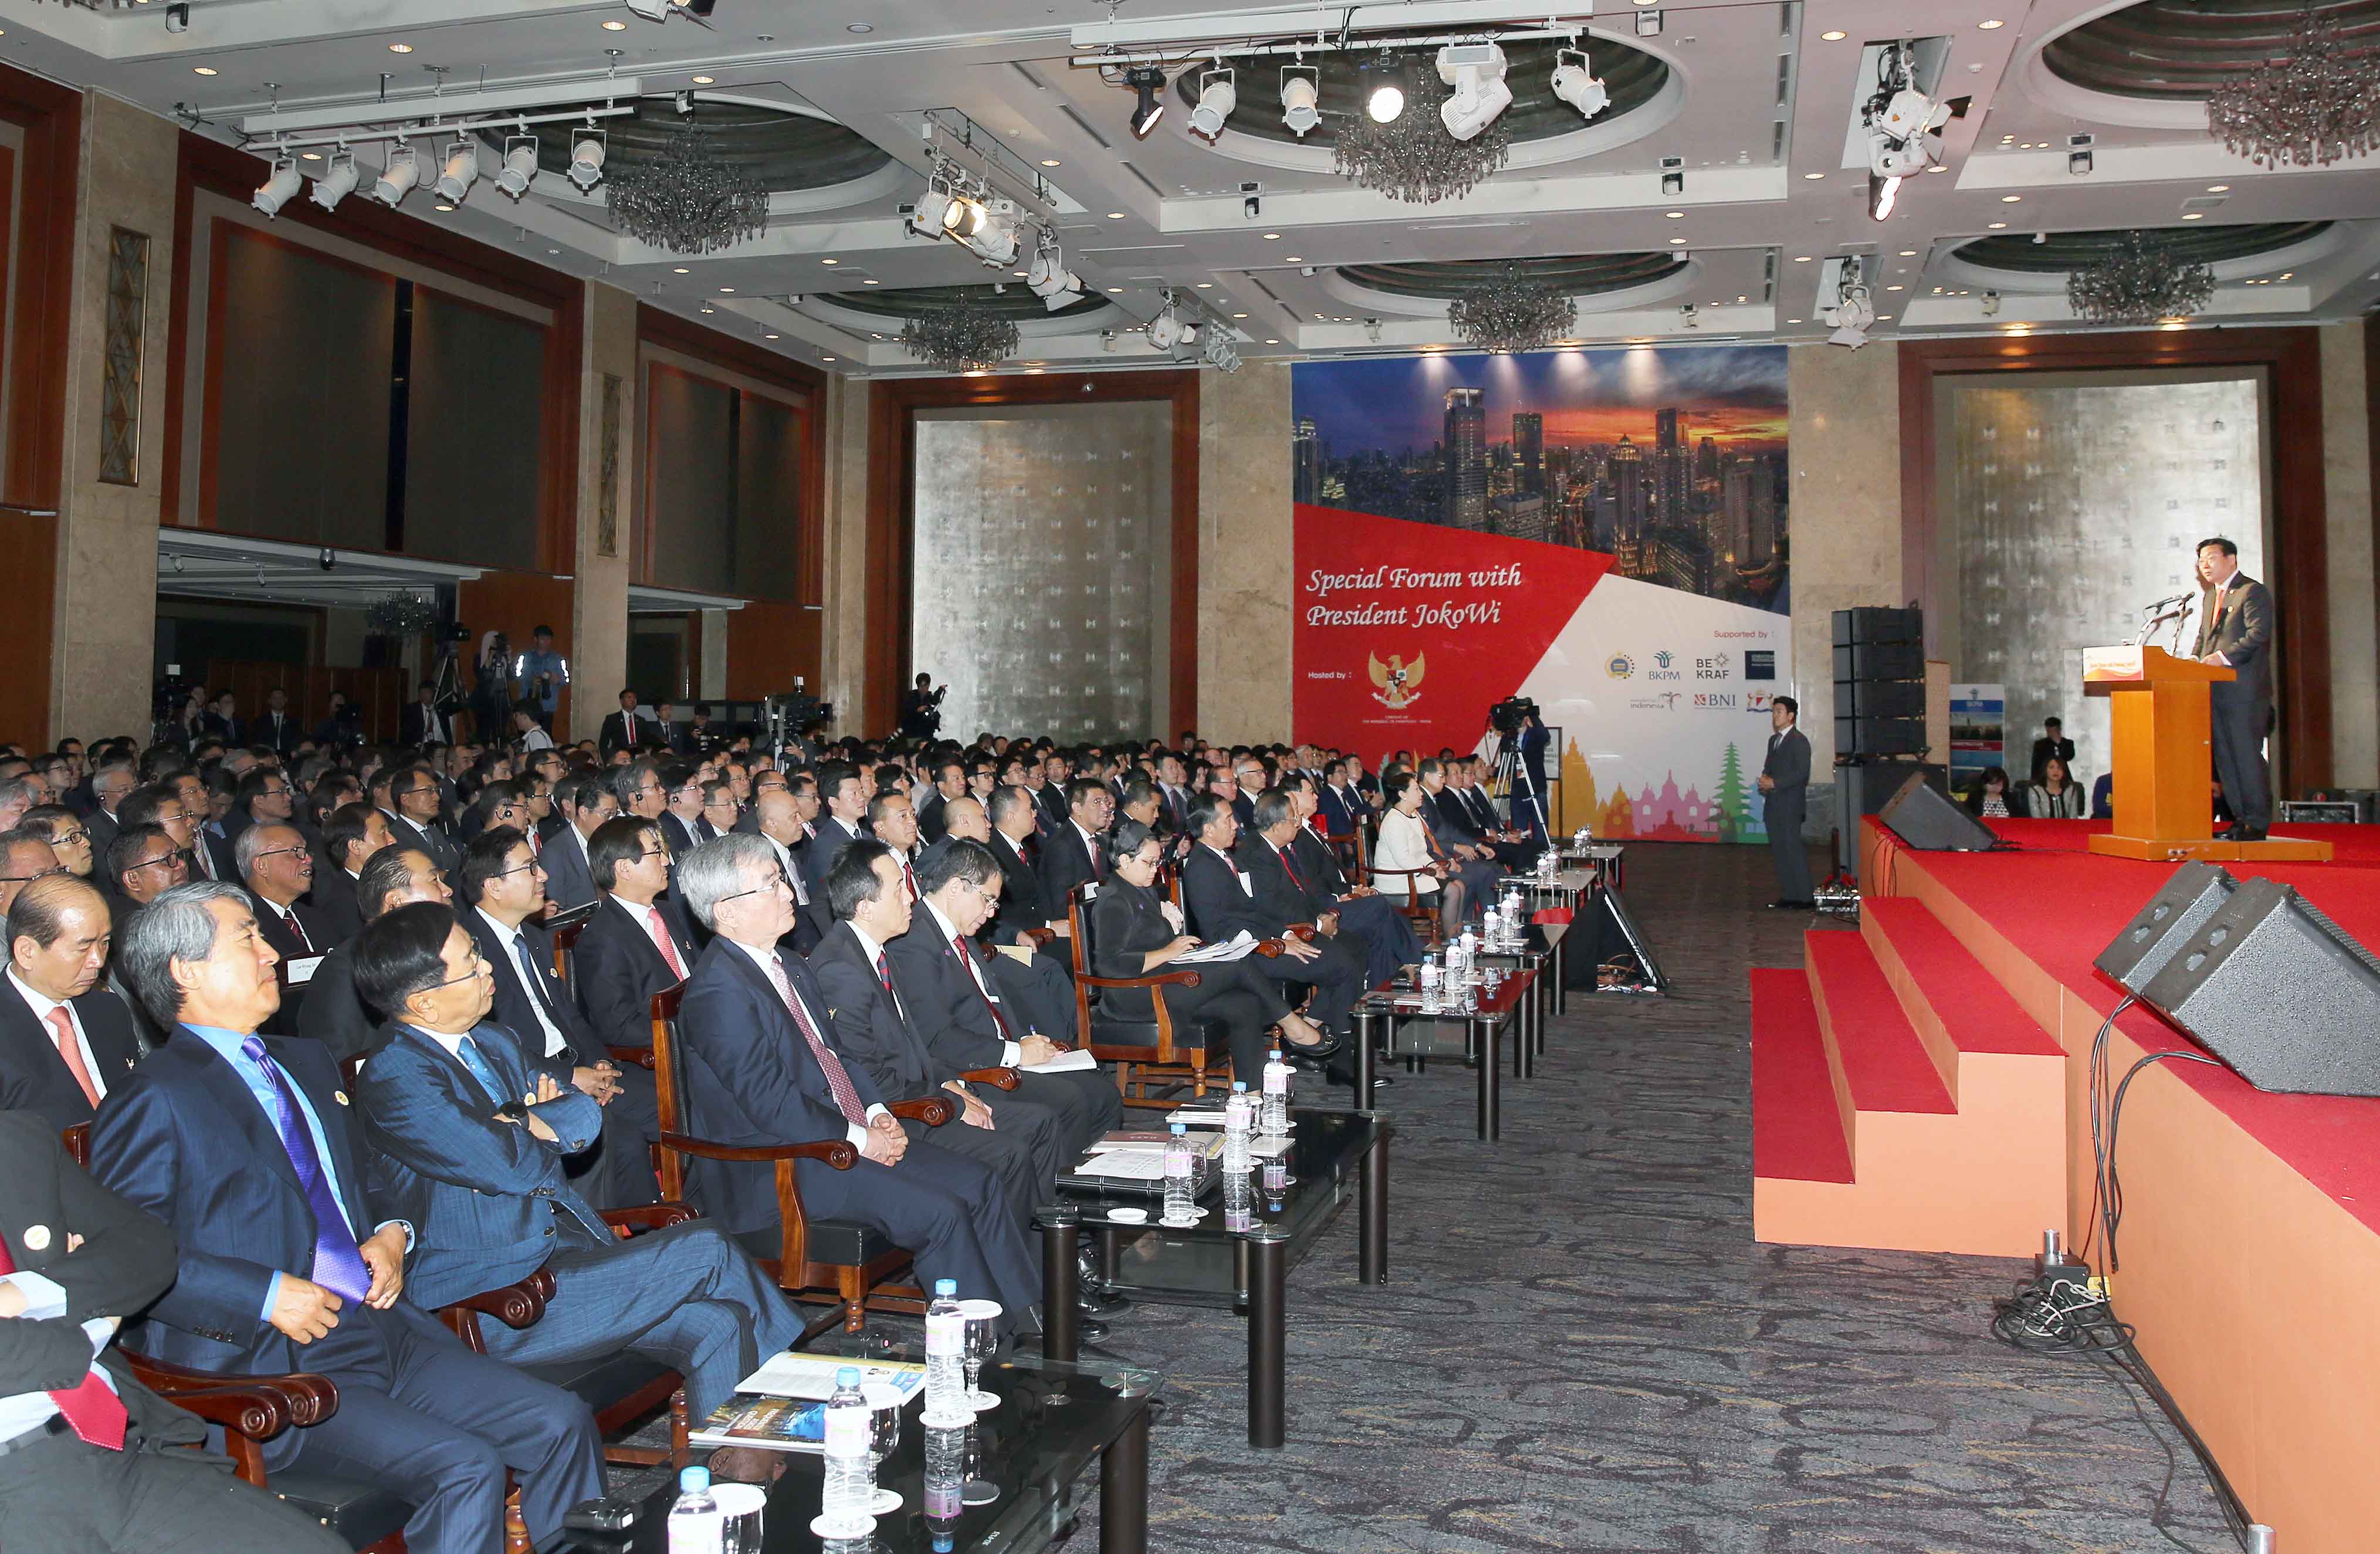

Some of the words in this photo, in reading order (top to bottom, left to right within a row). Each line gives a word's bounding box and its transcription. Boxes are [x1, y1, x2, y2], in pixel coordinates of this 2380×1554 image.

[1306, 565, 1388, 597] Special
[1390, 568, 1462, 588] Forum
[1468, 563, 1522, 587] with
[1306, 602, 1407, 626] President
[1411, 600, 1502, 629] JokoWi
[1714, 630, 1756, 639] Supported
[1758, 630, 1768, 639] by
[1696, 659, 1712, 668] BE
[1336, 671, 1346, 680] by
[1648, 671, 1681, 680] BKPM
[1696, 670, 1729, 679] KRAF
[1709, 694, 1736, 706] BNI
